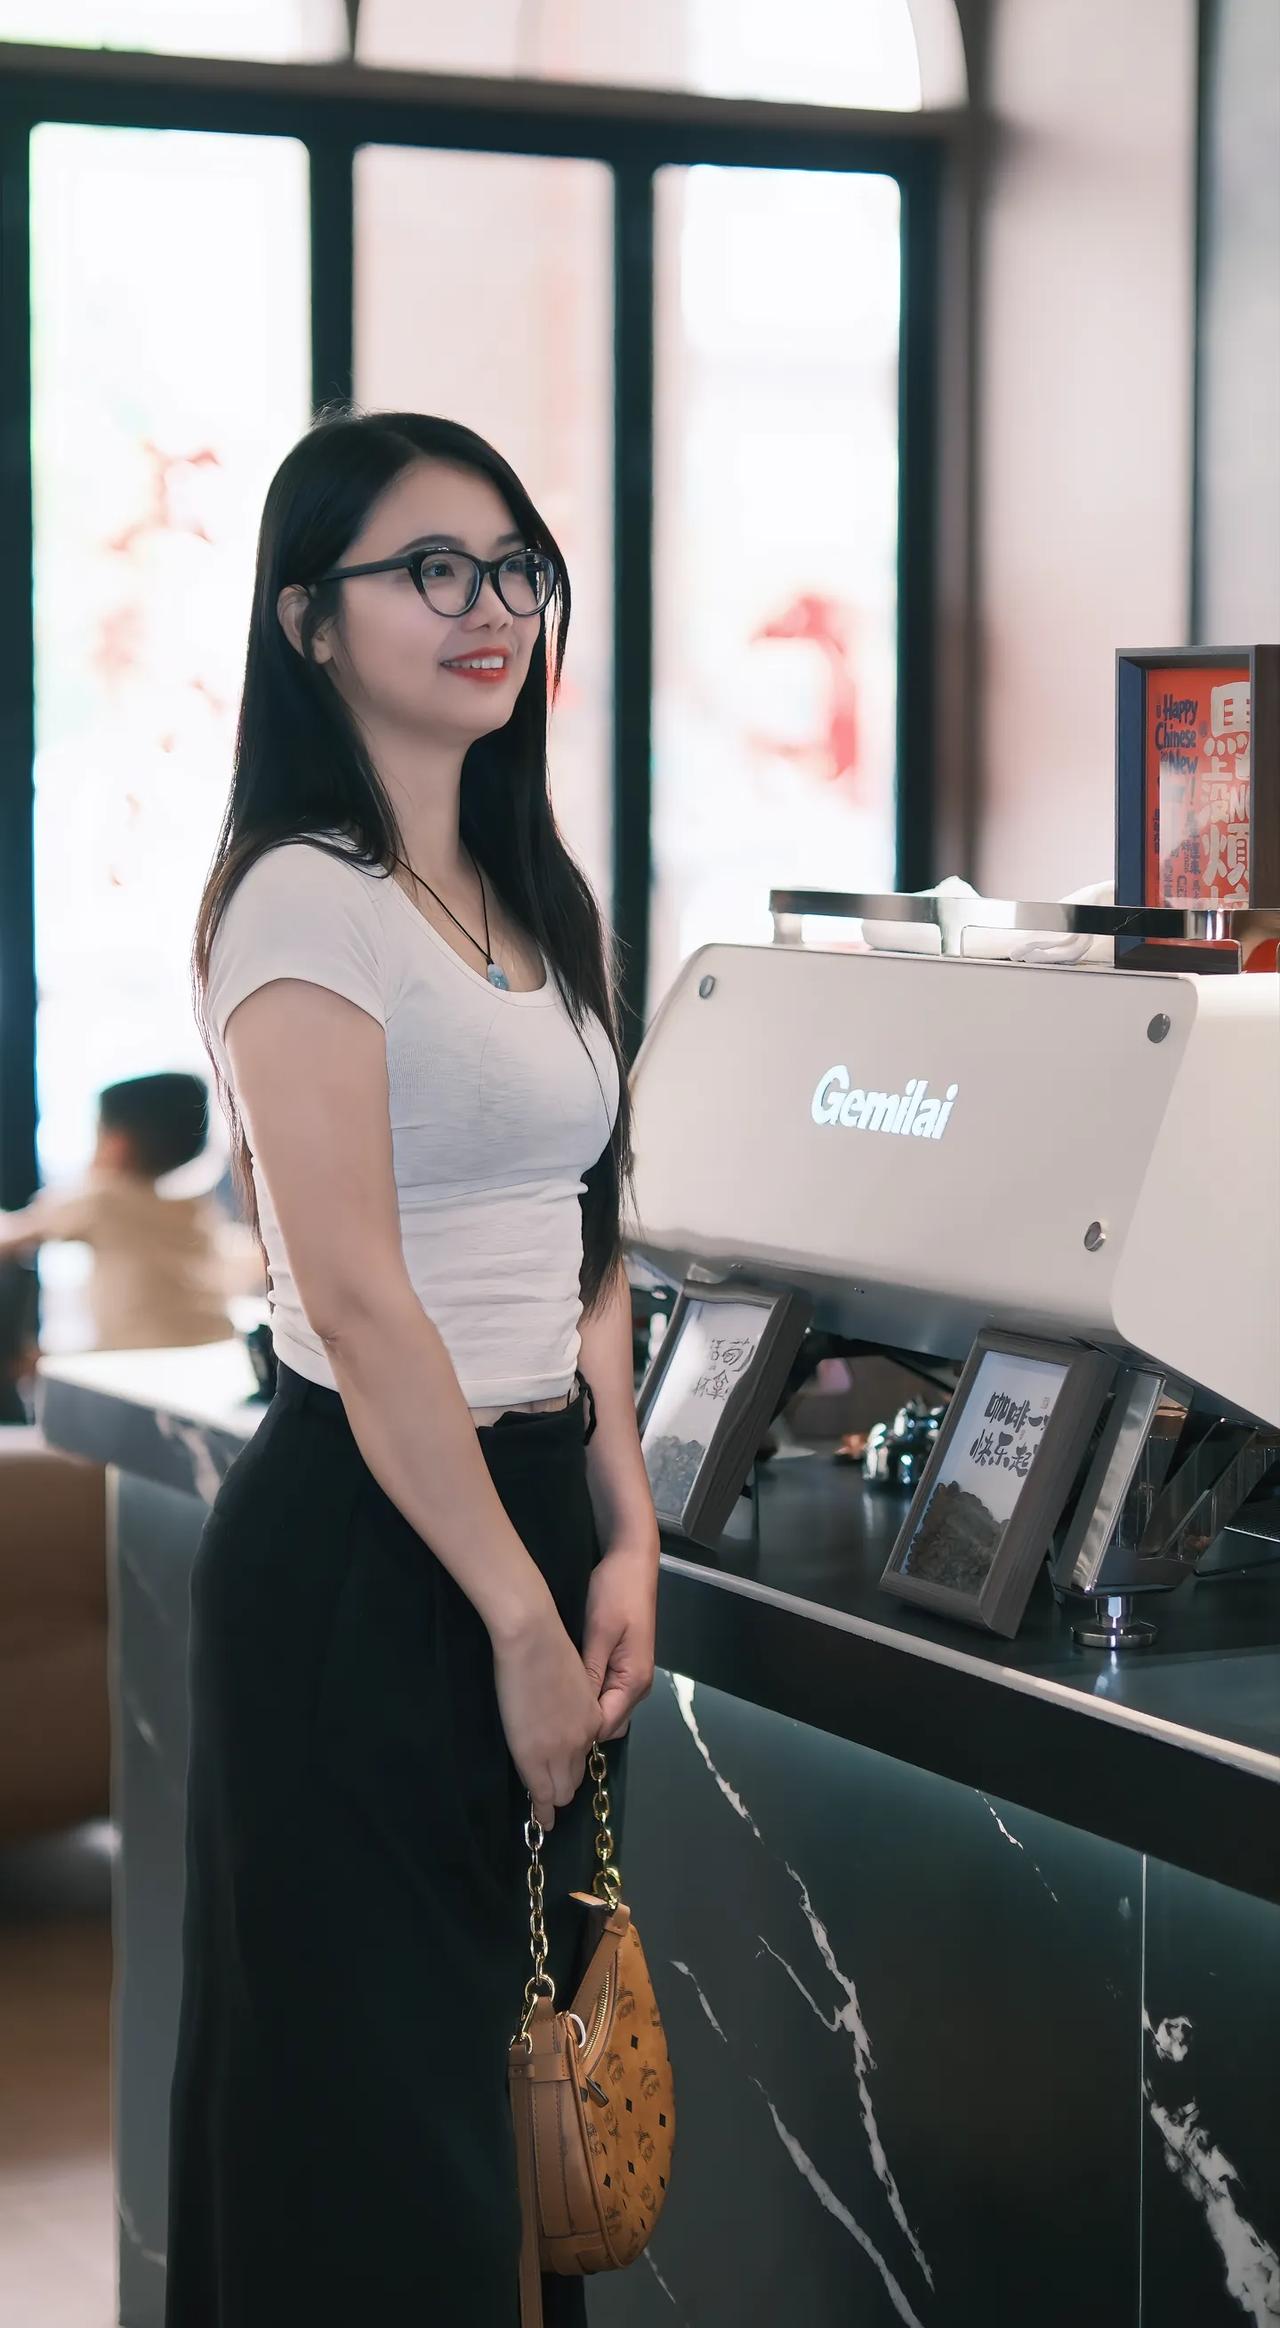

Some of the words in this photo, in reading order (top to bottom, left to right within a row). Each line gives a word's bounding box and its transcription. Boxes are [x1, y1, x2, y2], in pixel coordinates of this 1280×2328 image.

[1163, 693, 1198, 725] Happy
[1155, 721, 1197, 751] Chinese
[1168, 750, 1198, 774] New
[811, 1065, 958, 1140] Gemilai
[969, 1428, 1040, 1478] 快乐起
